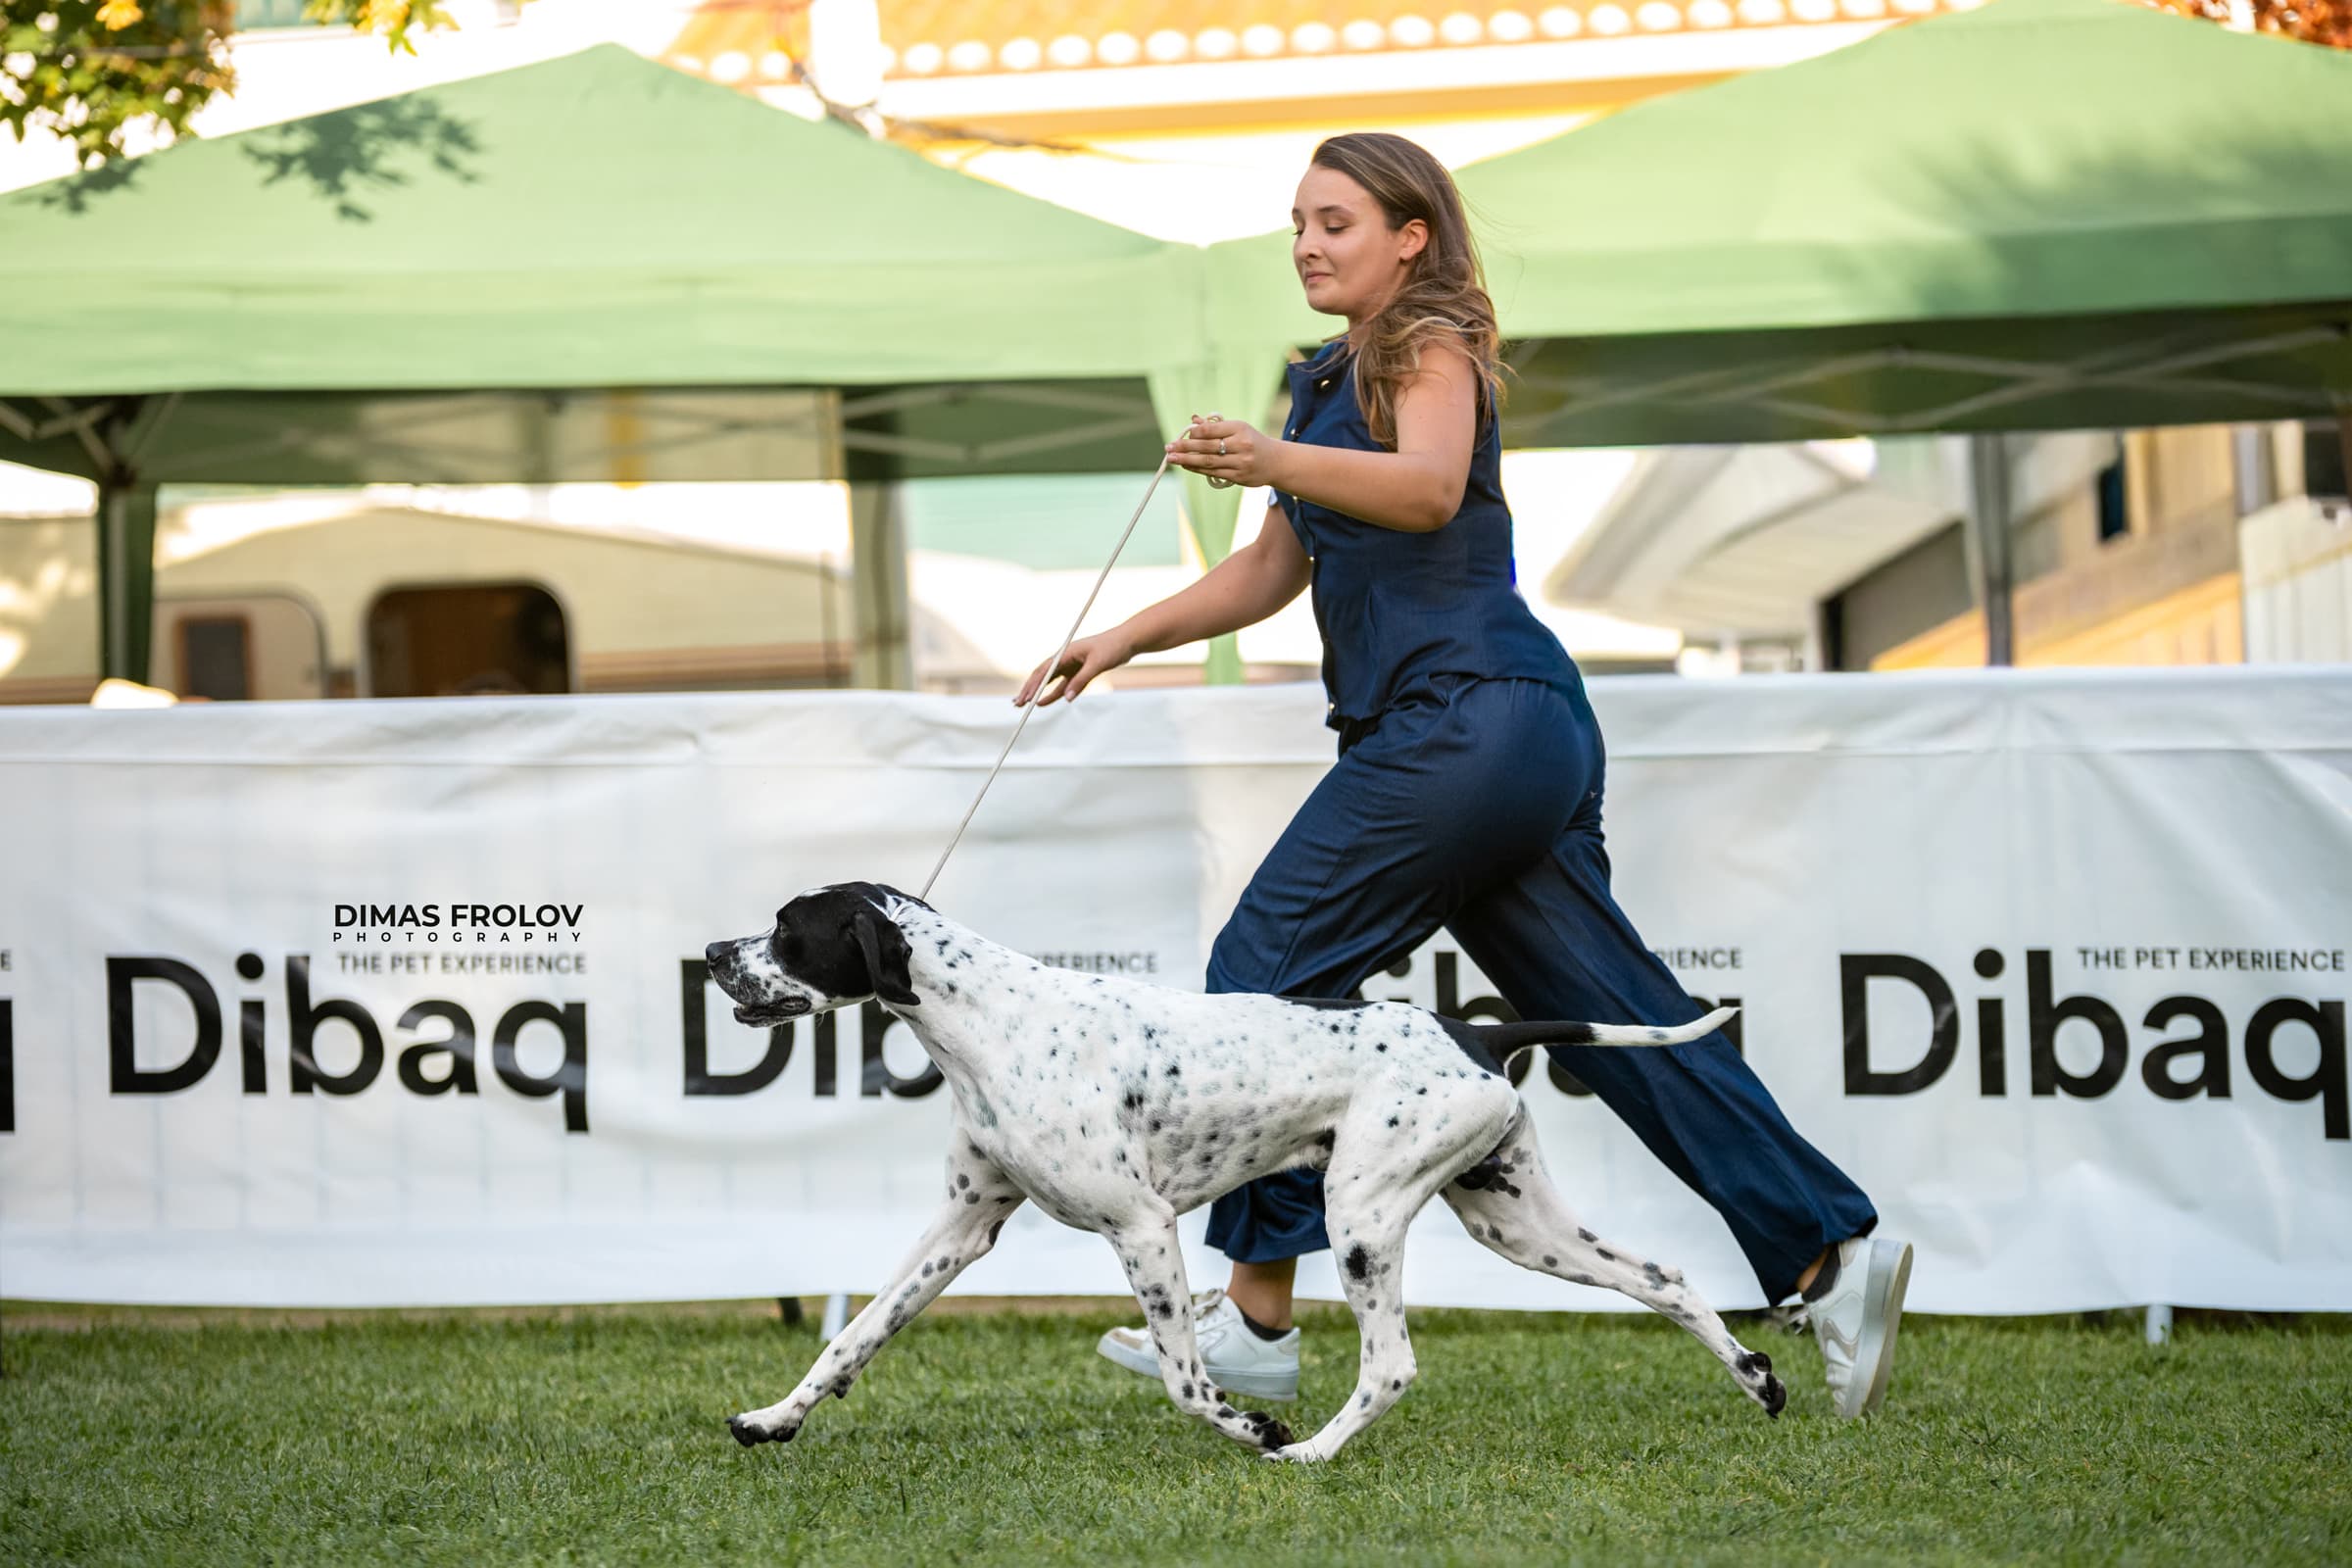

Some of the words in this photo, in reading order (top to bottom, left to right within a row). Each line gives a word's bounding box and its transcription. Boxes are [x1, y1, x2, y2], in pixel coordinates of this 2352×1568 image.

[337, 951, 383, 973] THE
[392, 951, 431, 973] PET
[441, 951, 587, 974] EXPERIENCE
[1035, 951, 1157, 973] PERIENCE
[2078, 948, 2127, 969] THE
[2134, 948, 2180, 969] PET
[2188, 948, 2346, 972] EXPERIENCE
[105, 953, 588, 1133] Dibaq
[1839, 948, 2352, 1141] Dibaq
